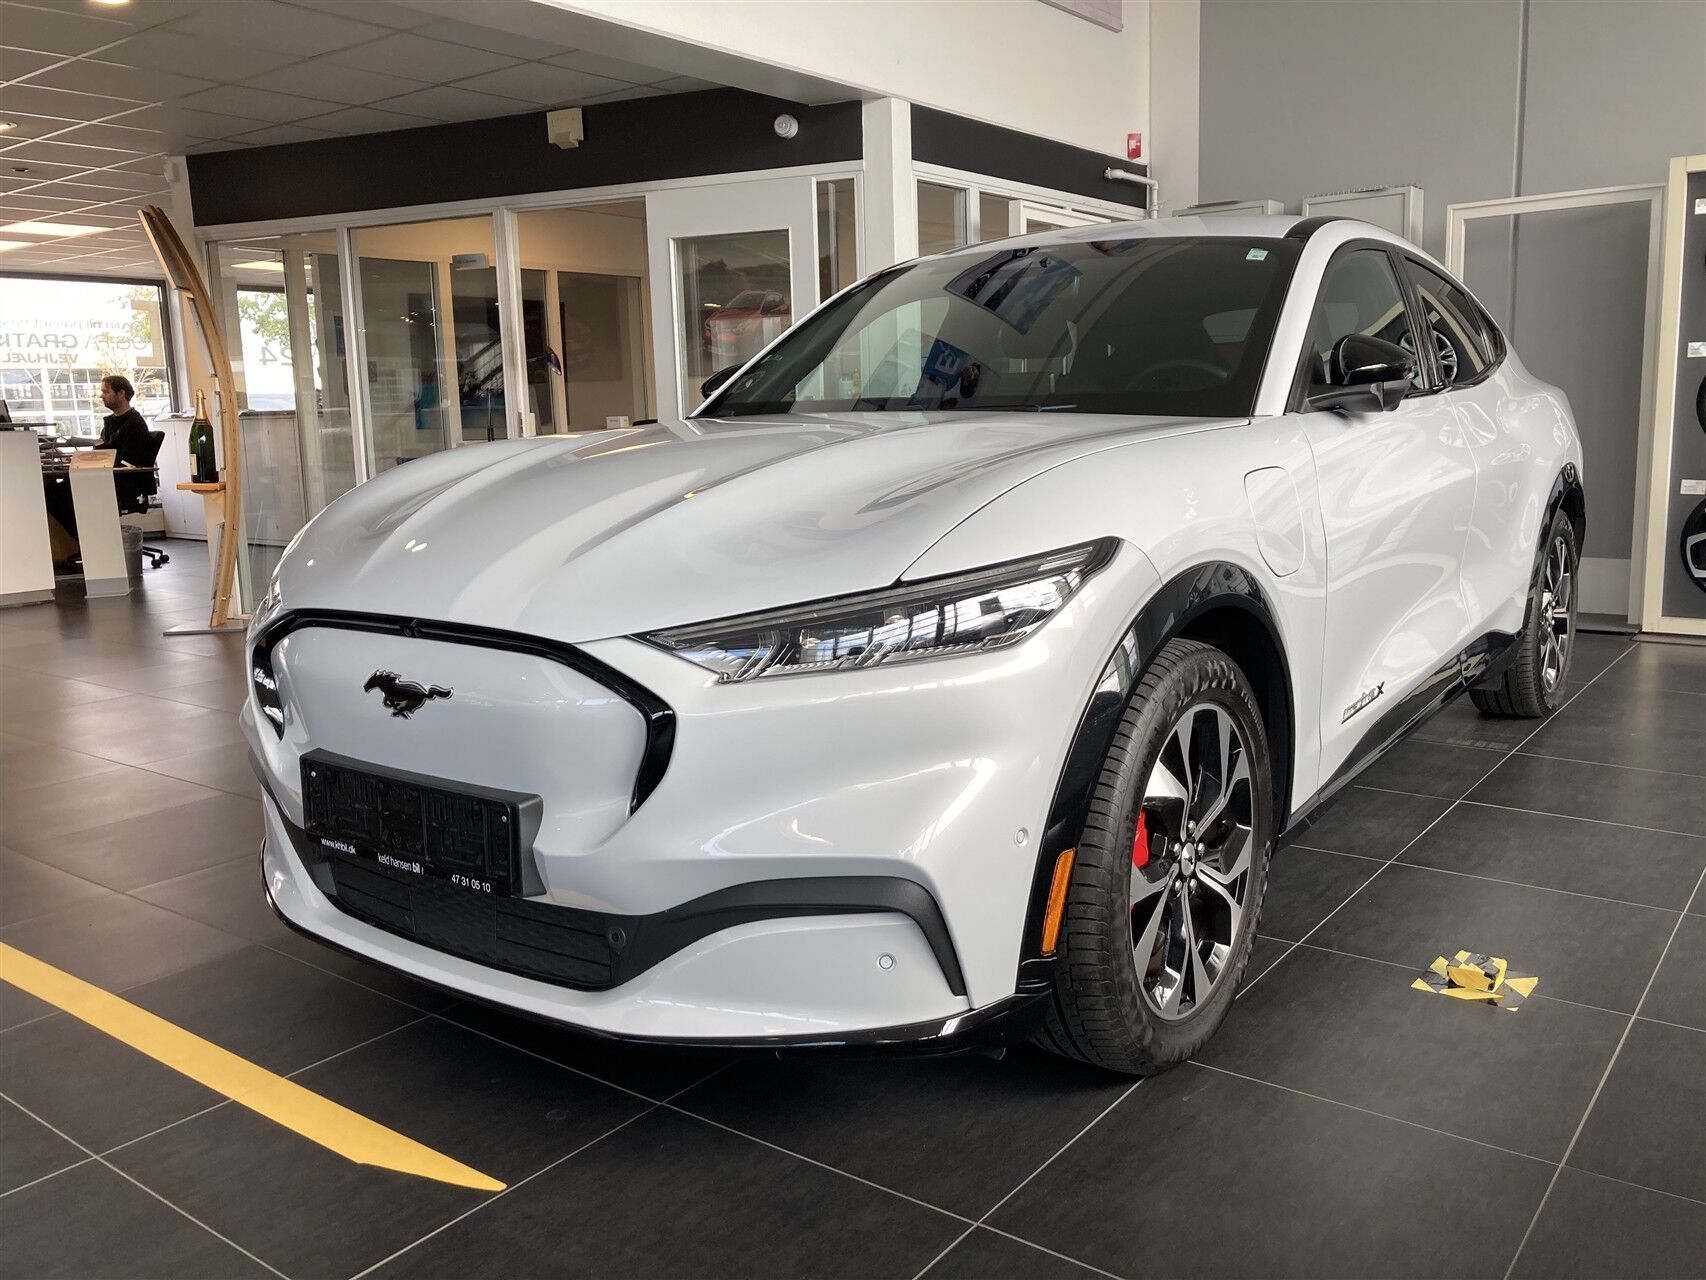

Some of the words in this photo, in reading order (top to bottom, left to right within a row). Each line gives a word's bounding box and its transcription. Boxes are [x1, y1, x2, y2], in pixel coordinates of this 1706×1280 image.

[377, 852, 390, 865] keld
[390, 856, 412, 871] hansen
[412, 862, 421, 874] bil
[451, 873, 460, 884] 47
[460, 876, 470, 887] 31
[471, 878, 481, 890] 05
[482, 882, 491, 893] 10
